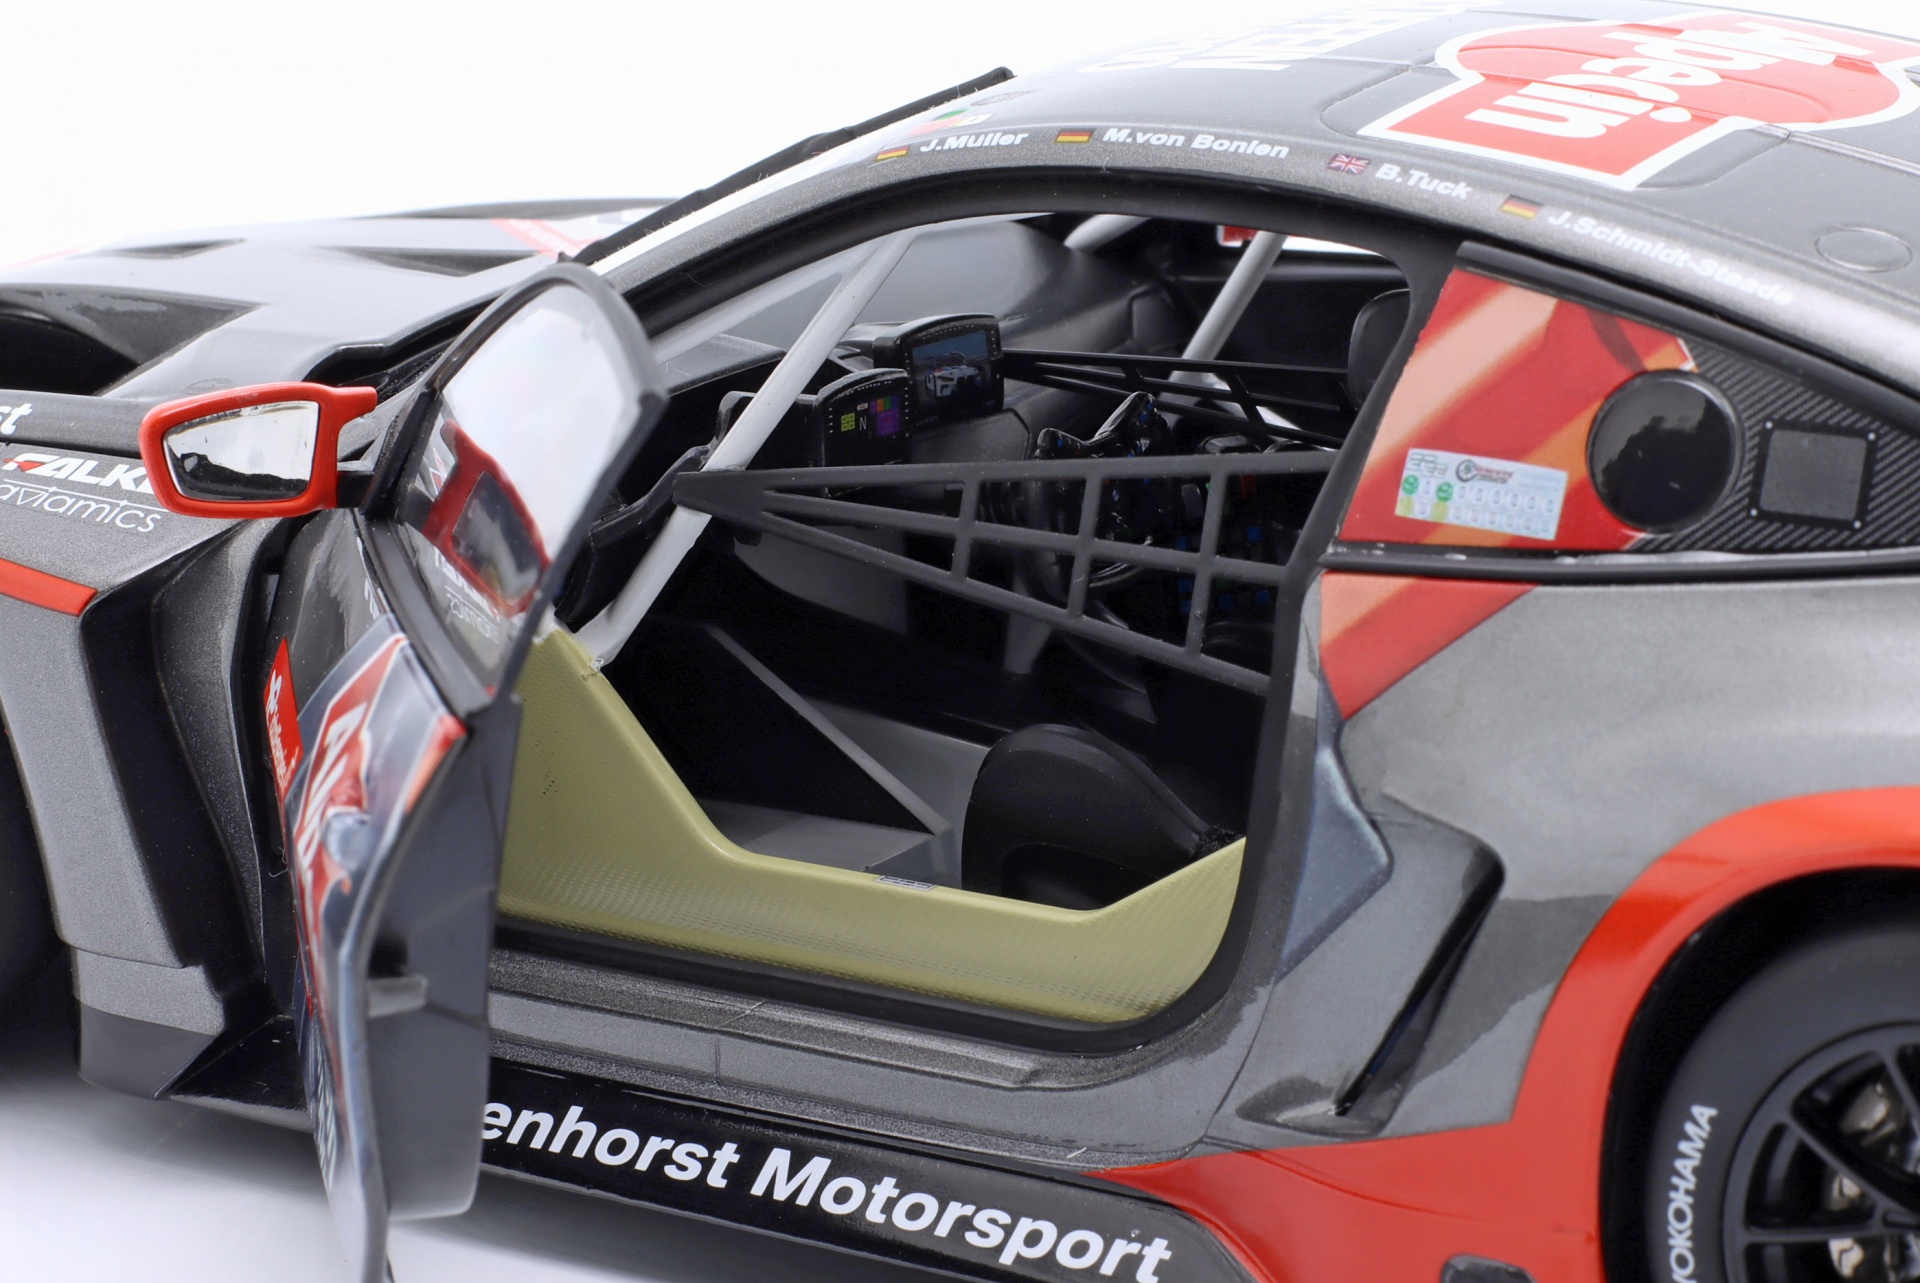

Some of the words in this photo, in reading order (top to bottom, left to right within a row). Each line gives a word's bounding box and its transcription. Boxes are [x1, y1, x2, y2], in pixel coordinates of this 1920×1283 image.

[1464, 20, 1873, 139] Alpecin
[1102, 127, 1186, 148] M.von
[1374, 162, 1474, 200] B.Tuck
[1, 452, 155, 496] FALK
[749, 1147, 1173, 1283] Motorsport
